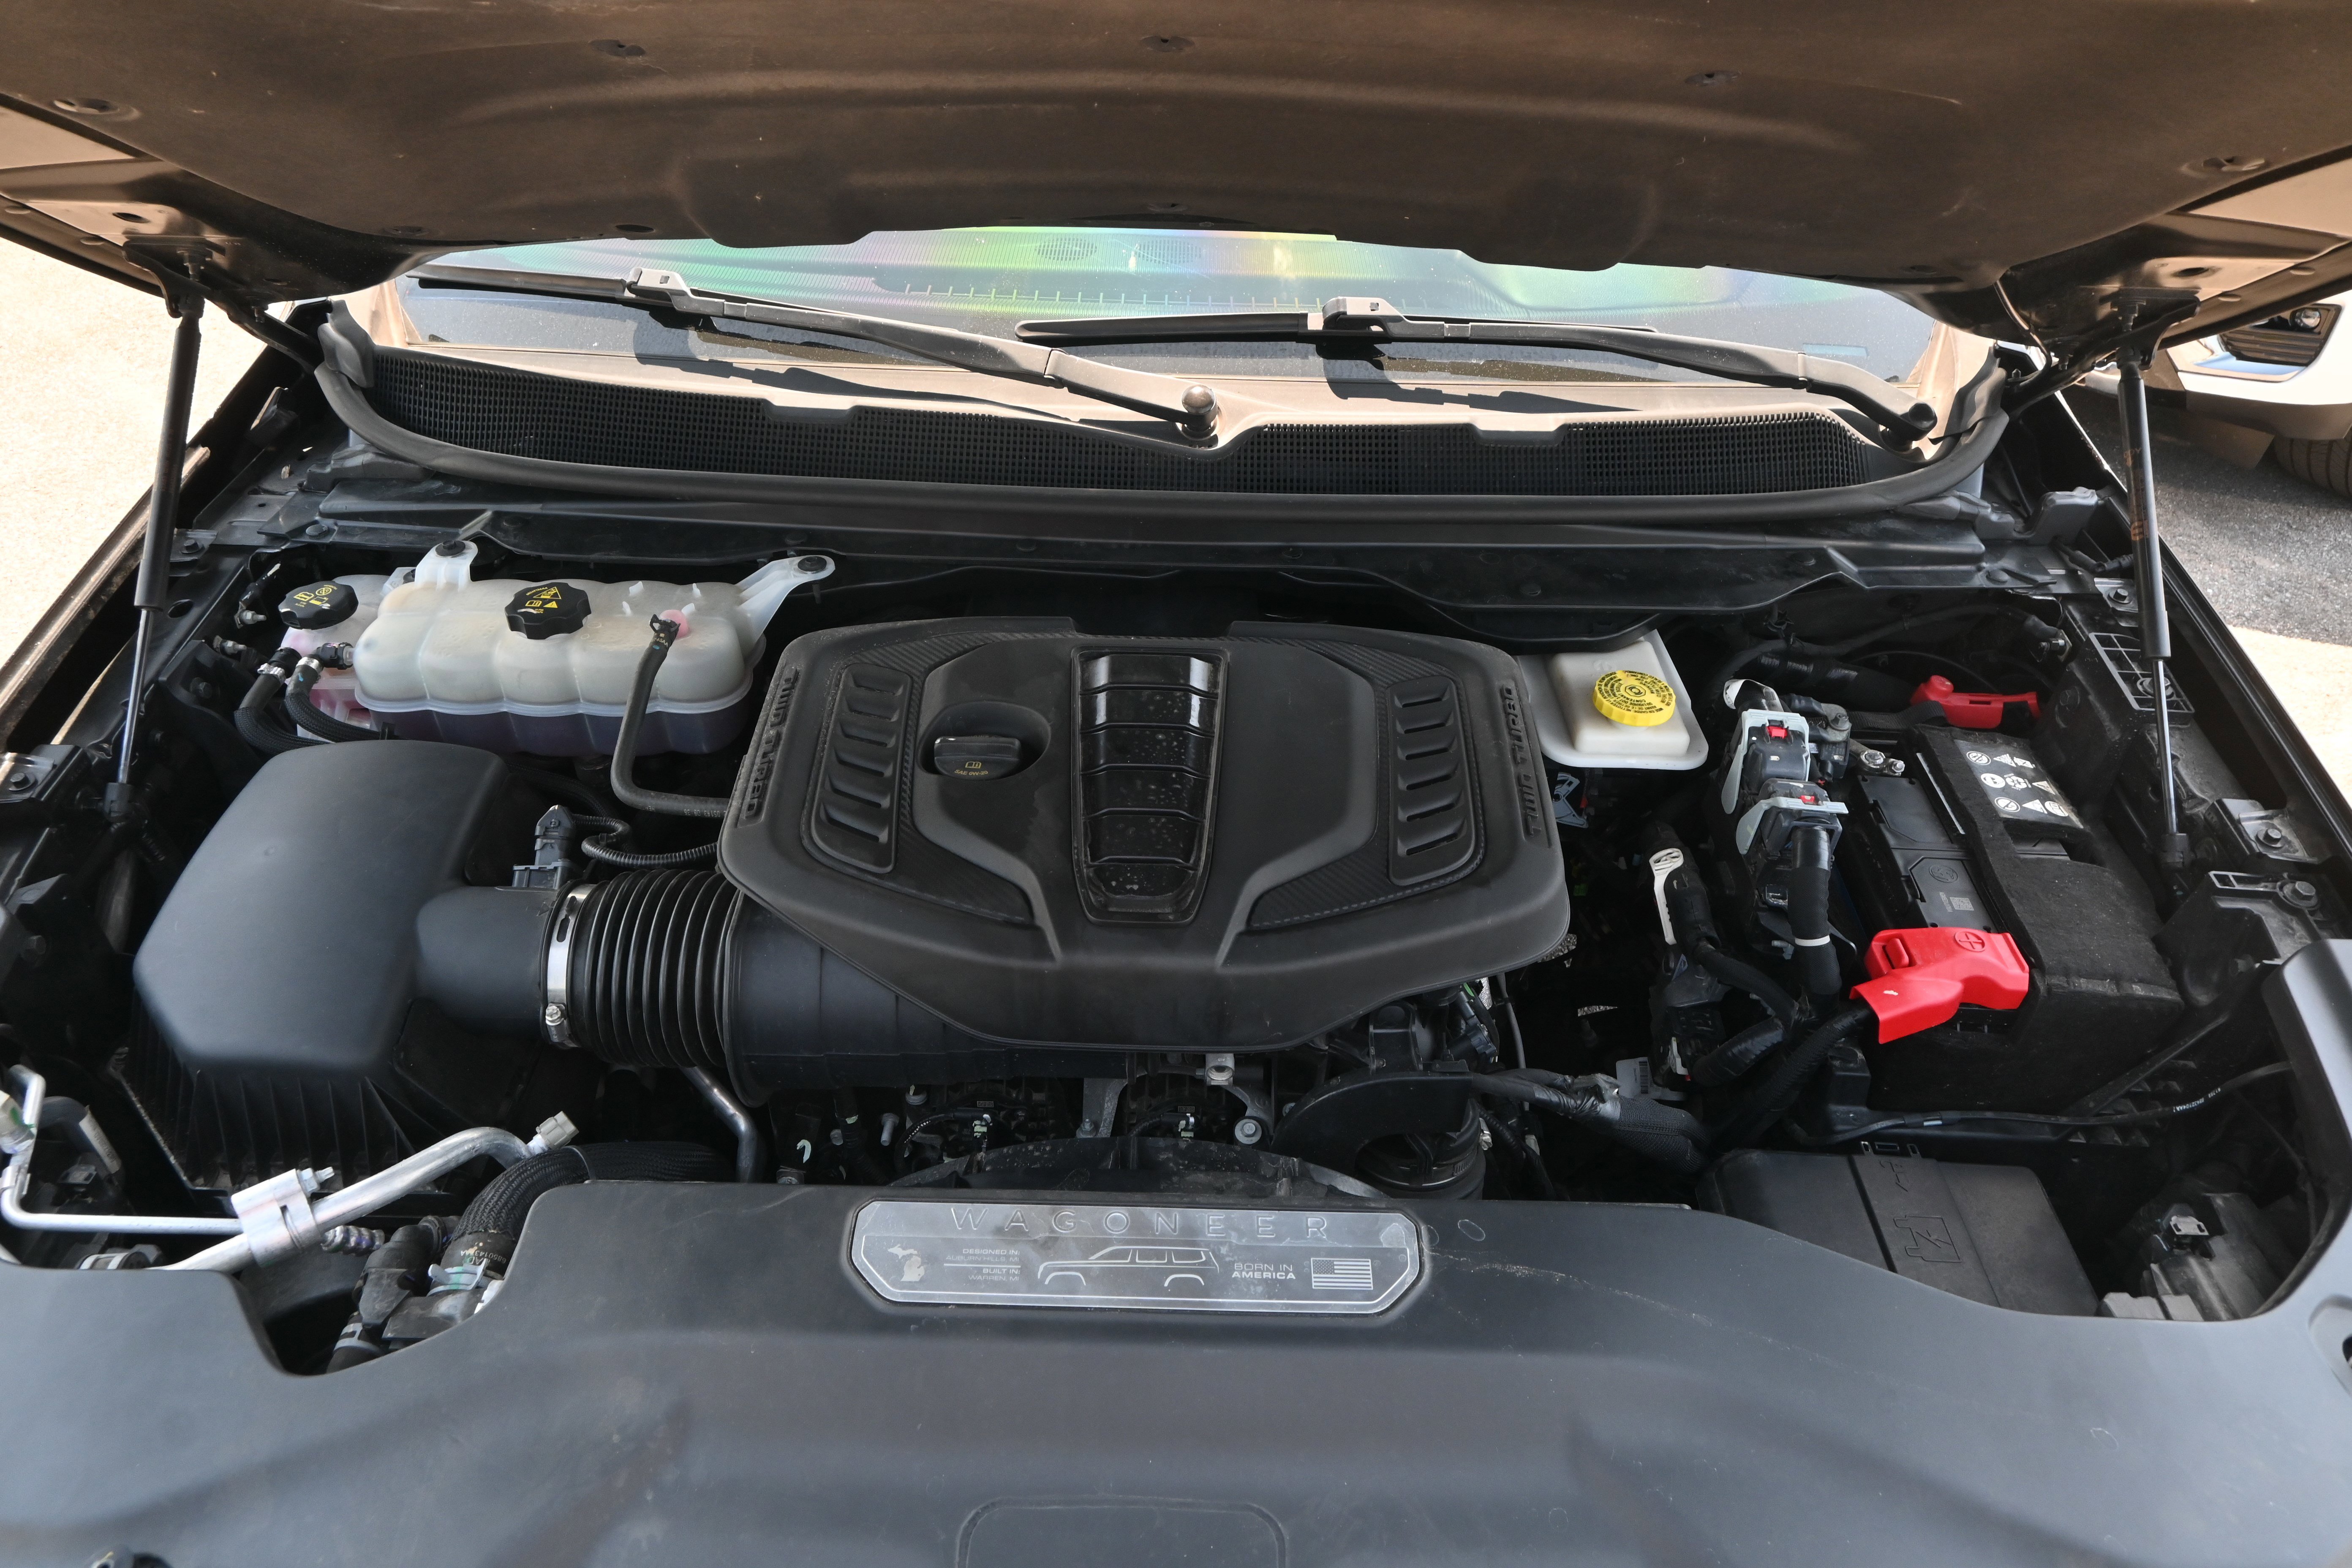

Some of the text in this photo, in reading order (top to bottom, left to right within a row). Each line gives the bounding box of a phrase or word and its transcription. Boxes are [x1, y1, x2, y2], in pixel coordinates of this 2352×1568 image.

[1610, 702, 1631, 712] NETTOYER
[1502, 682, 1529, 765] TURBO
[744, 730, 780, 818] TURBO
[951, 1207, 1328, 1239] WAGONEER
[1232, 1271, 1296, 1279] AMERICA
